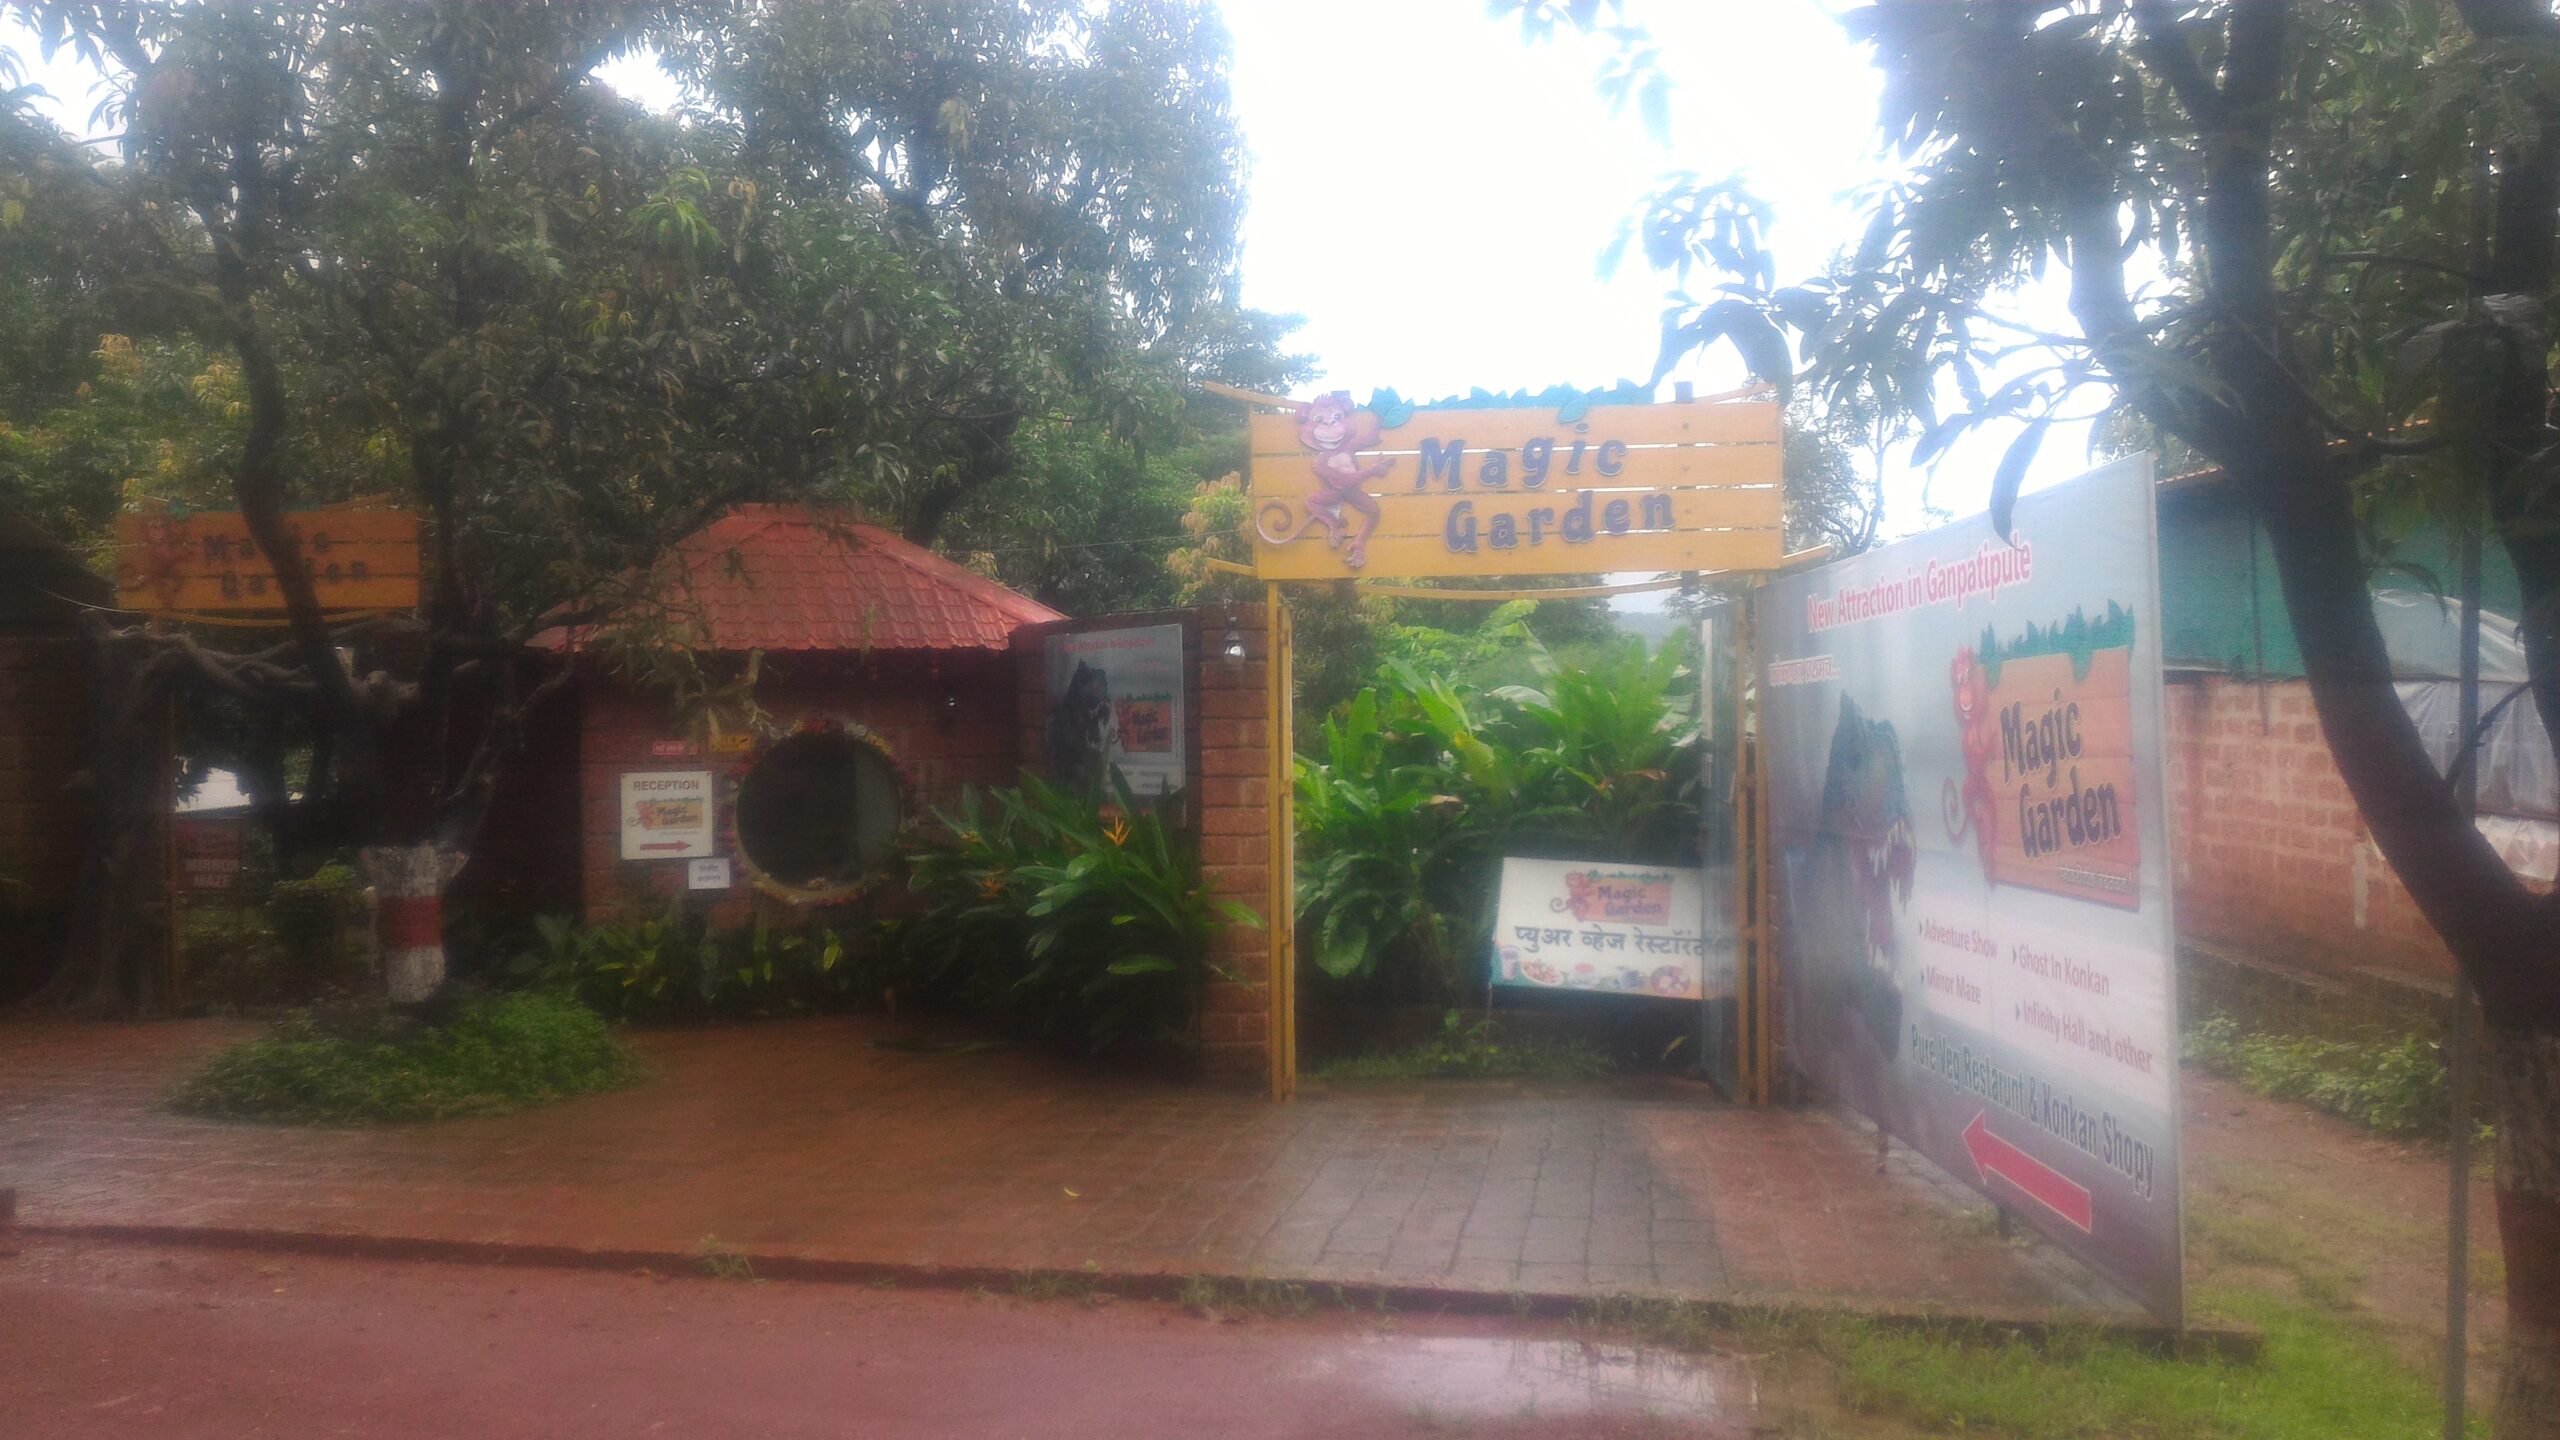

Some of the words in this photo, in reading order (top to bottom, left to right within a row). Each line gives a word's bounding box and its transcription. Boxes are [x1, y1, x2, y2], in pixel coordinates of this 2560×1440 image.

[1414, 422, 1626, 492] Magic
[1445, 489, 1677, 555] Garden
[1807, 595, 1834, 632] New
[1838, 576, 1904, 624] Attraction
[1907, 567, 1922, 607] in
[1926, 533, 2031, 608] Ganpatipule
[2000, 688, 2082, 788] Magic
[633, 779, 699, 791] RECEPTION
[2020, 766, 2121, 860] Garden
[1597, 884, 1647, 899] Magic
[1605, 902, 1663, 917] Garden
[1514, 926, 1574, 953] प्युअर
[1924, 918, 1971, 951] Adventure
[1971, 931, 1998, 960] Show
[1925, 965, 1954, 994] Mirror
[1956, 975, 1982, 1005] Maze
[2018, 944, 2050, 972] Ghost
[2064, 957, 2110, 997] Konkan
[2022, 1000, 2061, 1043] Infinity
[2062, 1013, 2086, 1046] Hall
[2087, 1023, 2113, 1053] and
[2113, 1035, 2152, 1074] other
[1911, 1022, 1937, 1073] Pure
[1938, 1033, 1960, 1094] Veg
[2028, 1075, 2039, 1125] &
[2042, 1082, 2098, 1159] Konkan
[2102, 1110, 2154, 1201] Shopy
